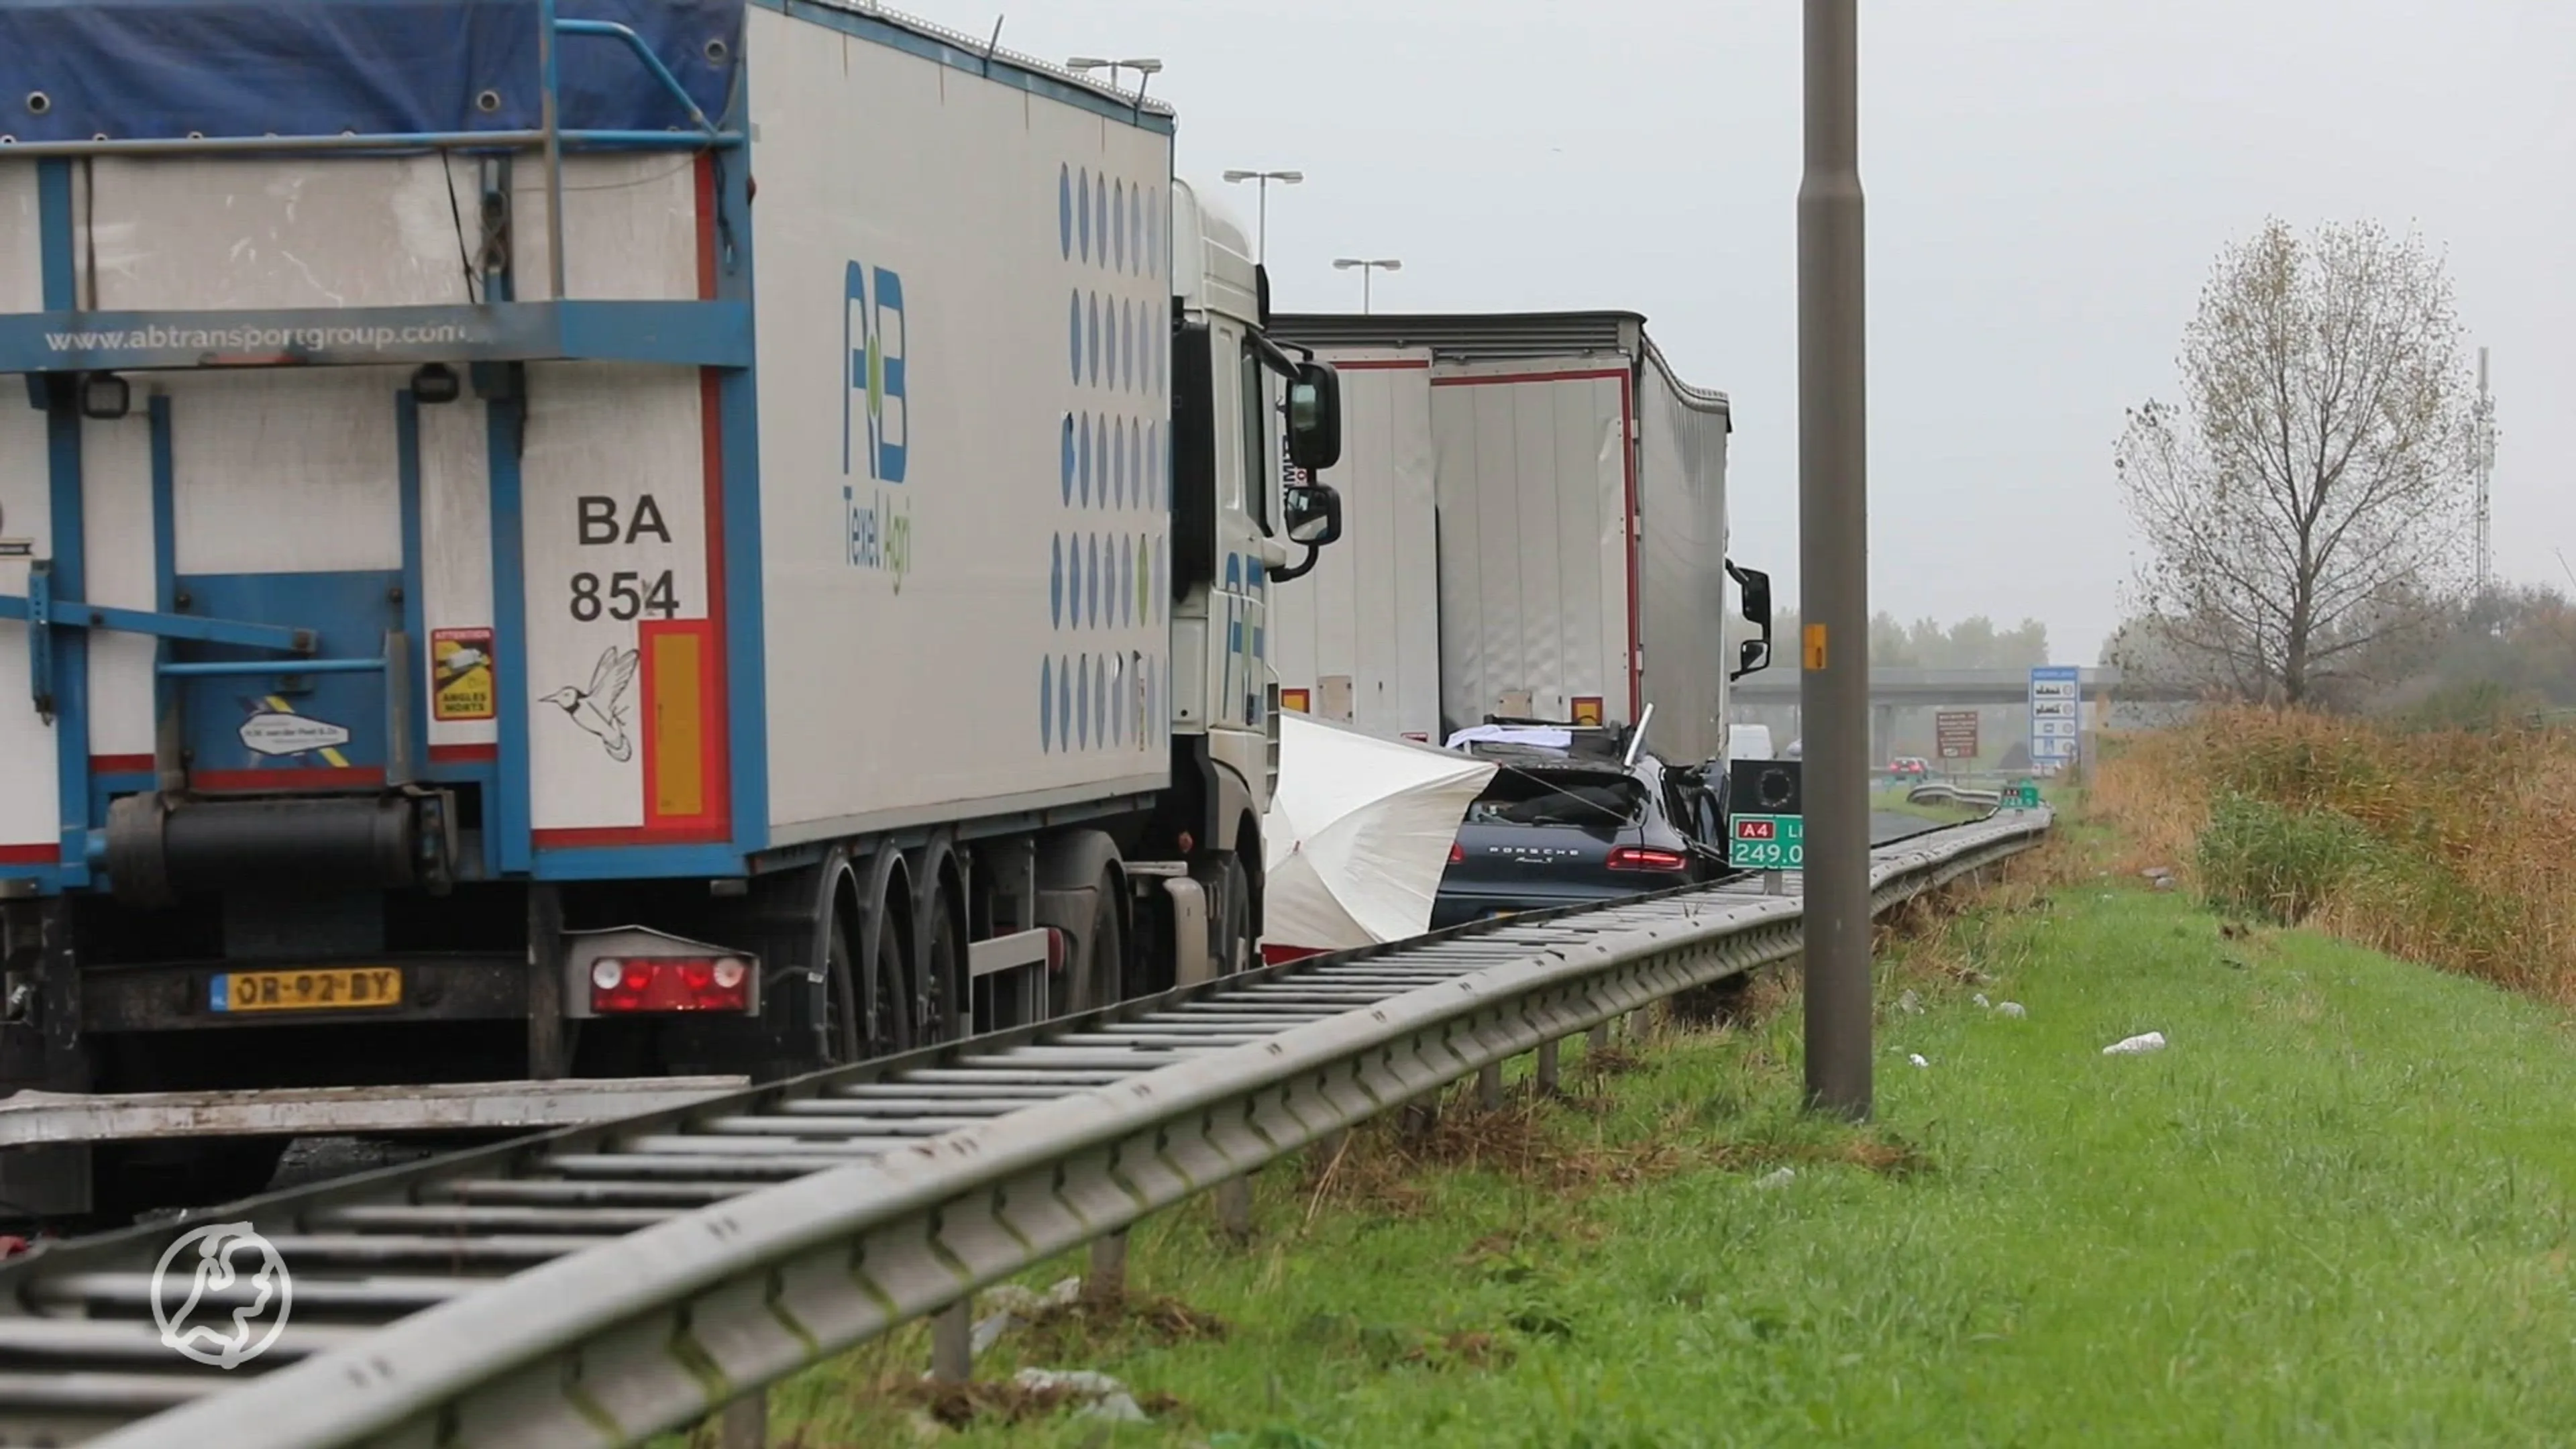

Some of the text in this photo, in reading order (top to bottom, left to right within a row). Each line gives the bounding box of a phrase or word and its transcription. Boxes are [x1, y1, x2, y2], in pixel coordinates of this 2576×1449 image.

[578, 494, 672, 545] BA
[843, 486, 911, 597] Texel Agri
[570, 570, 680, 622] 854
[443, 693, 486, 702] ANGLES
[1743, 824, 1768, 837] A4
[1489, 847, 1578, 855] PORSCHE
[1735, 844, 1803, 863] 249.0
